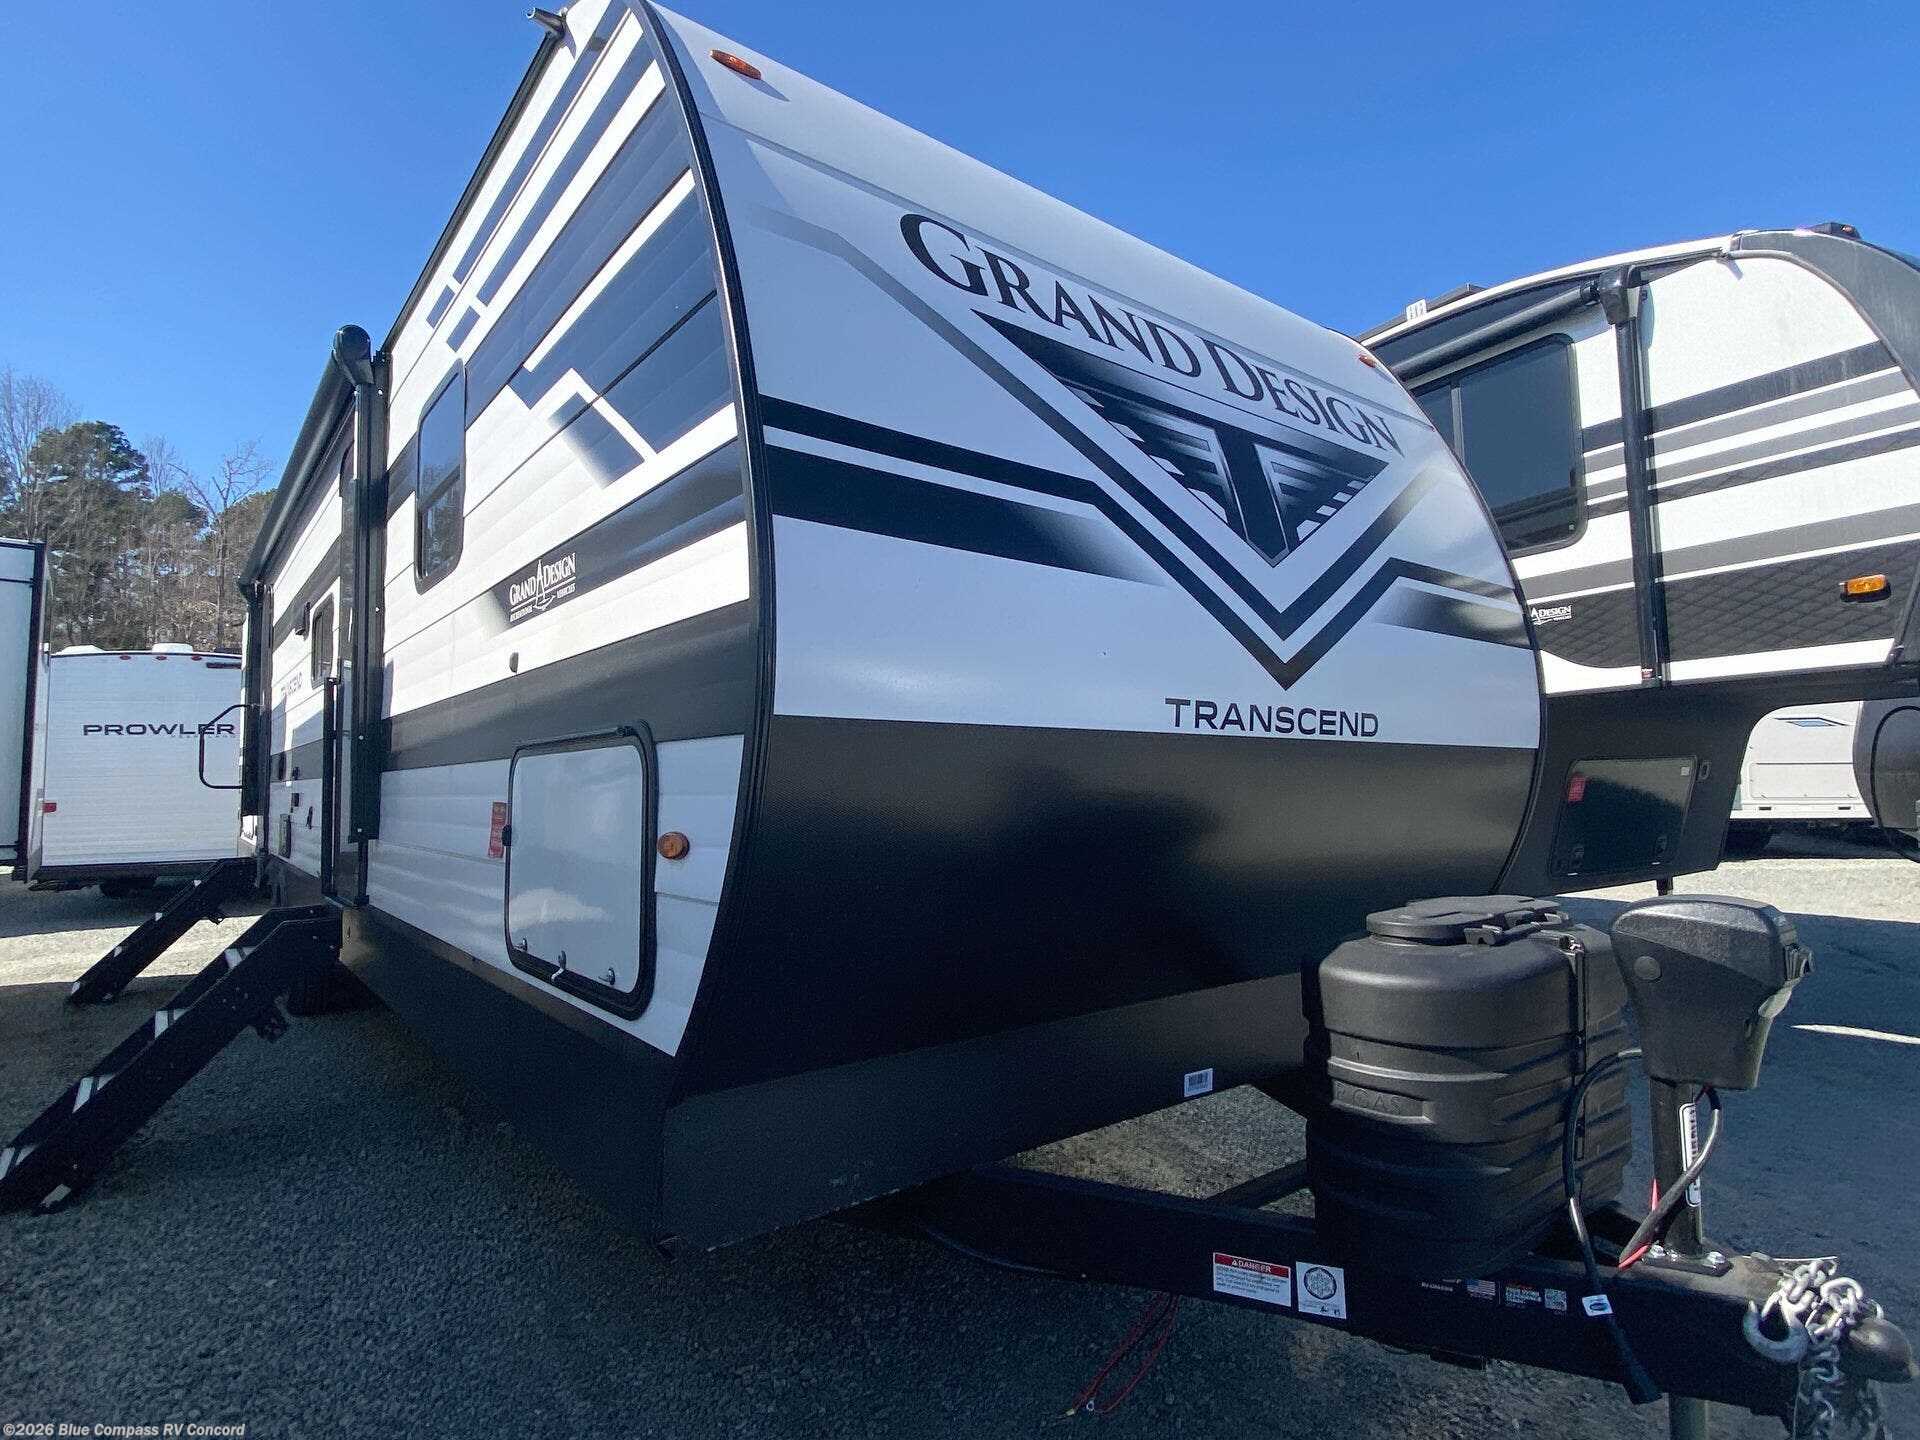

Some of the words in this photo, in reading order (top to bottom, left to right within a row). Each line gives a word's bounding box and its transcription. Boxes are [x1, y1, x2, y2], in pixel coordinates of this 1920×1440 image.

[899, 213, 1202, 379] GRAND
[1196, 335, 1405, 458] DESIGN
[509, 575, 537, 606] GRAND
[542, 552, 576, 588] DESIGN
[1538, 604, 1573, 618] DESIGN
[83, 723, 235, 736] PROWLER
[1164, 697, 1379, 737] TRANSCEND
[1237, 1260, 1272, 1273] DANGER
